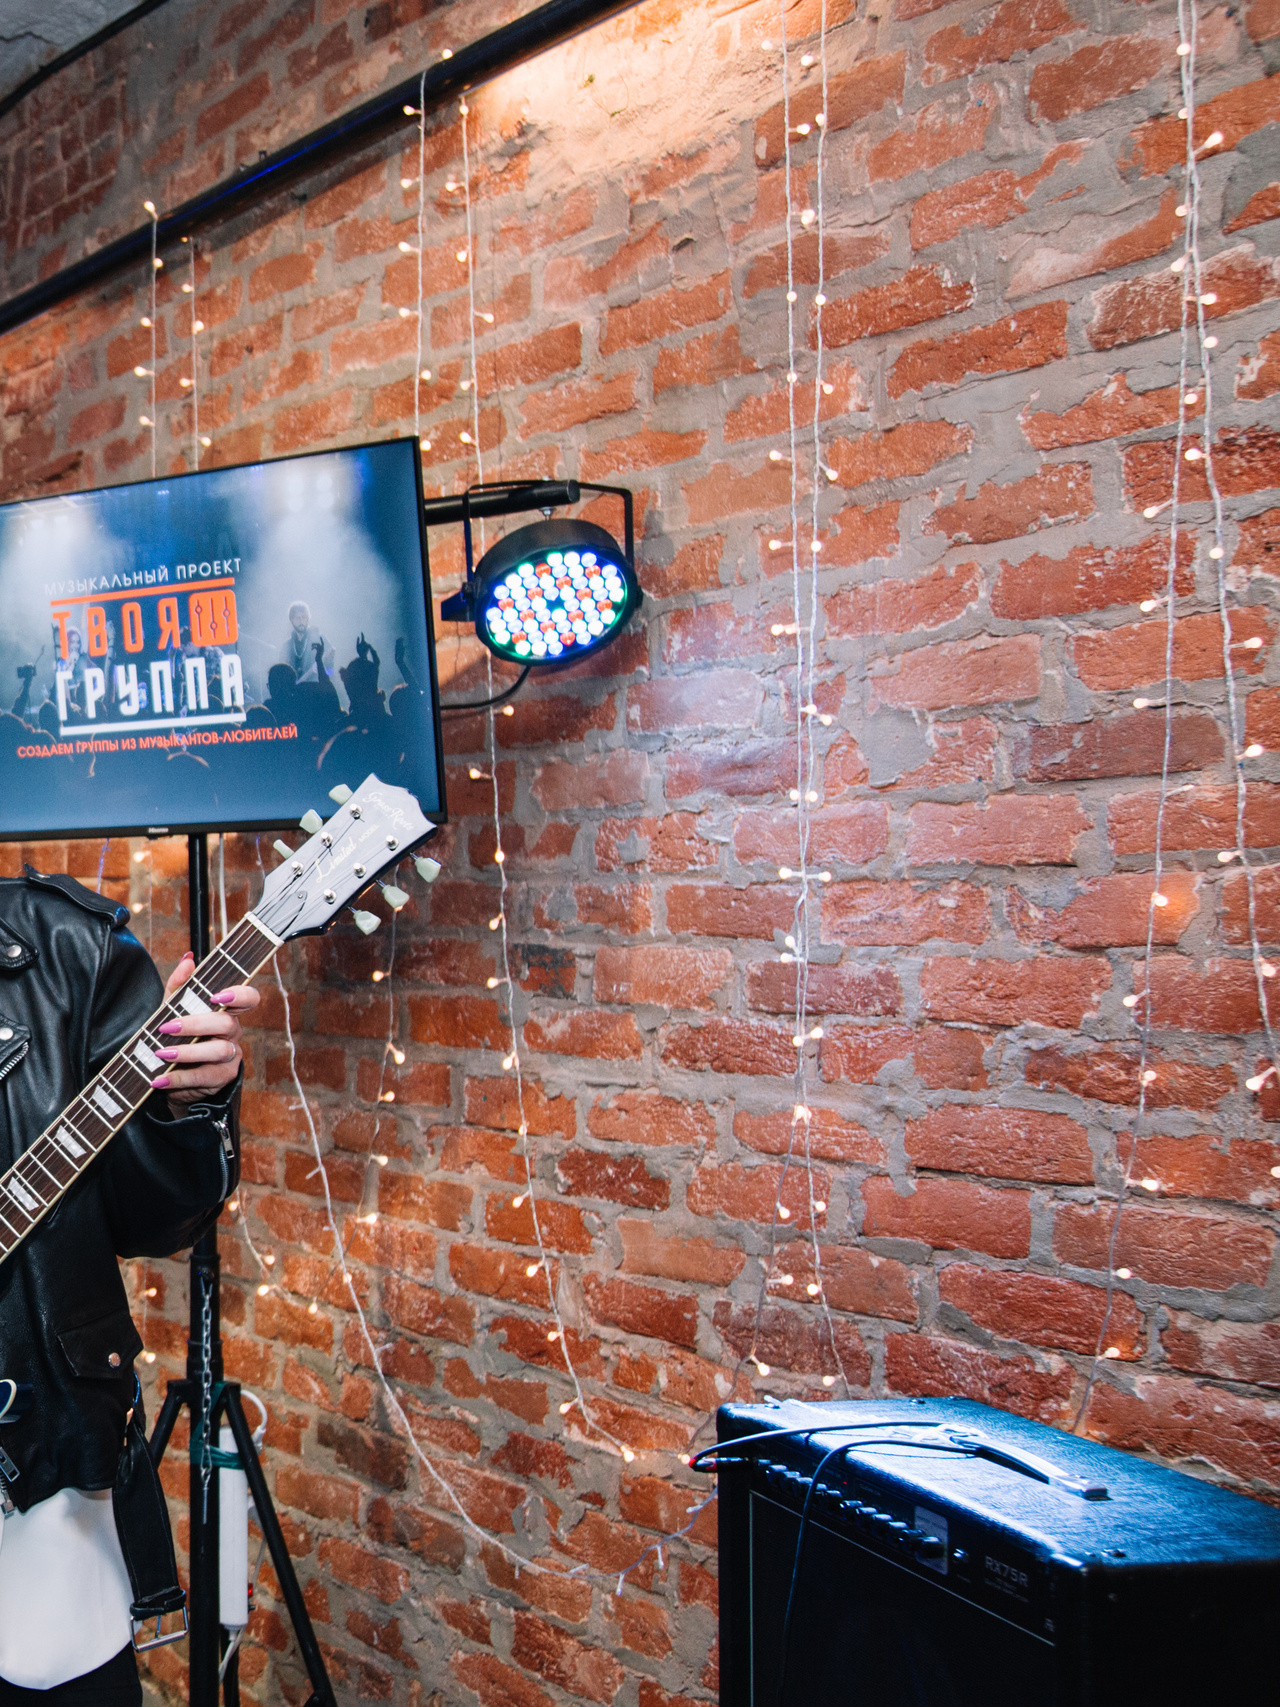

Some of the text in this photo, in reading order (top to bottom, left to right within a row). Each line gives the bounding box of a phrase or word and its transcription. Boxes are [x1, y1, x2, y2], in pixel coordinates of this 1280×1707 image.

[45, 558, 241, 596] МУЗЫКАЛЬНЫЙ ПРОЕКТ
[52, 597, 181, 660] ТВОЯ
[56, 654, 245, 721] ГРУППА
[17, 723, 298, 758] СОЗДАЕМ ГРУППЫ ИЗ МУЗЫКАНТОВ-ЛЮБИТЕЛЕЙ
[314, 837, 357, 884] Limited
